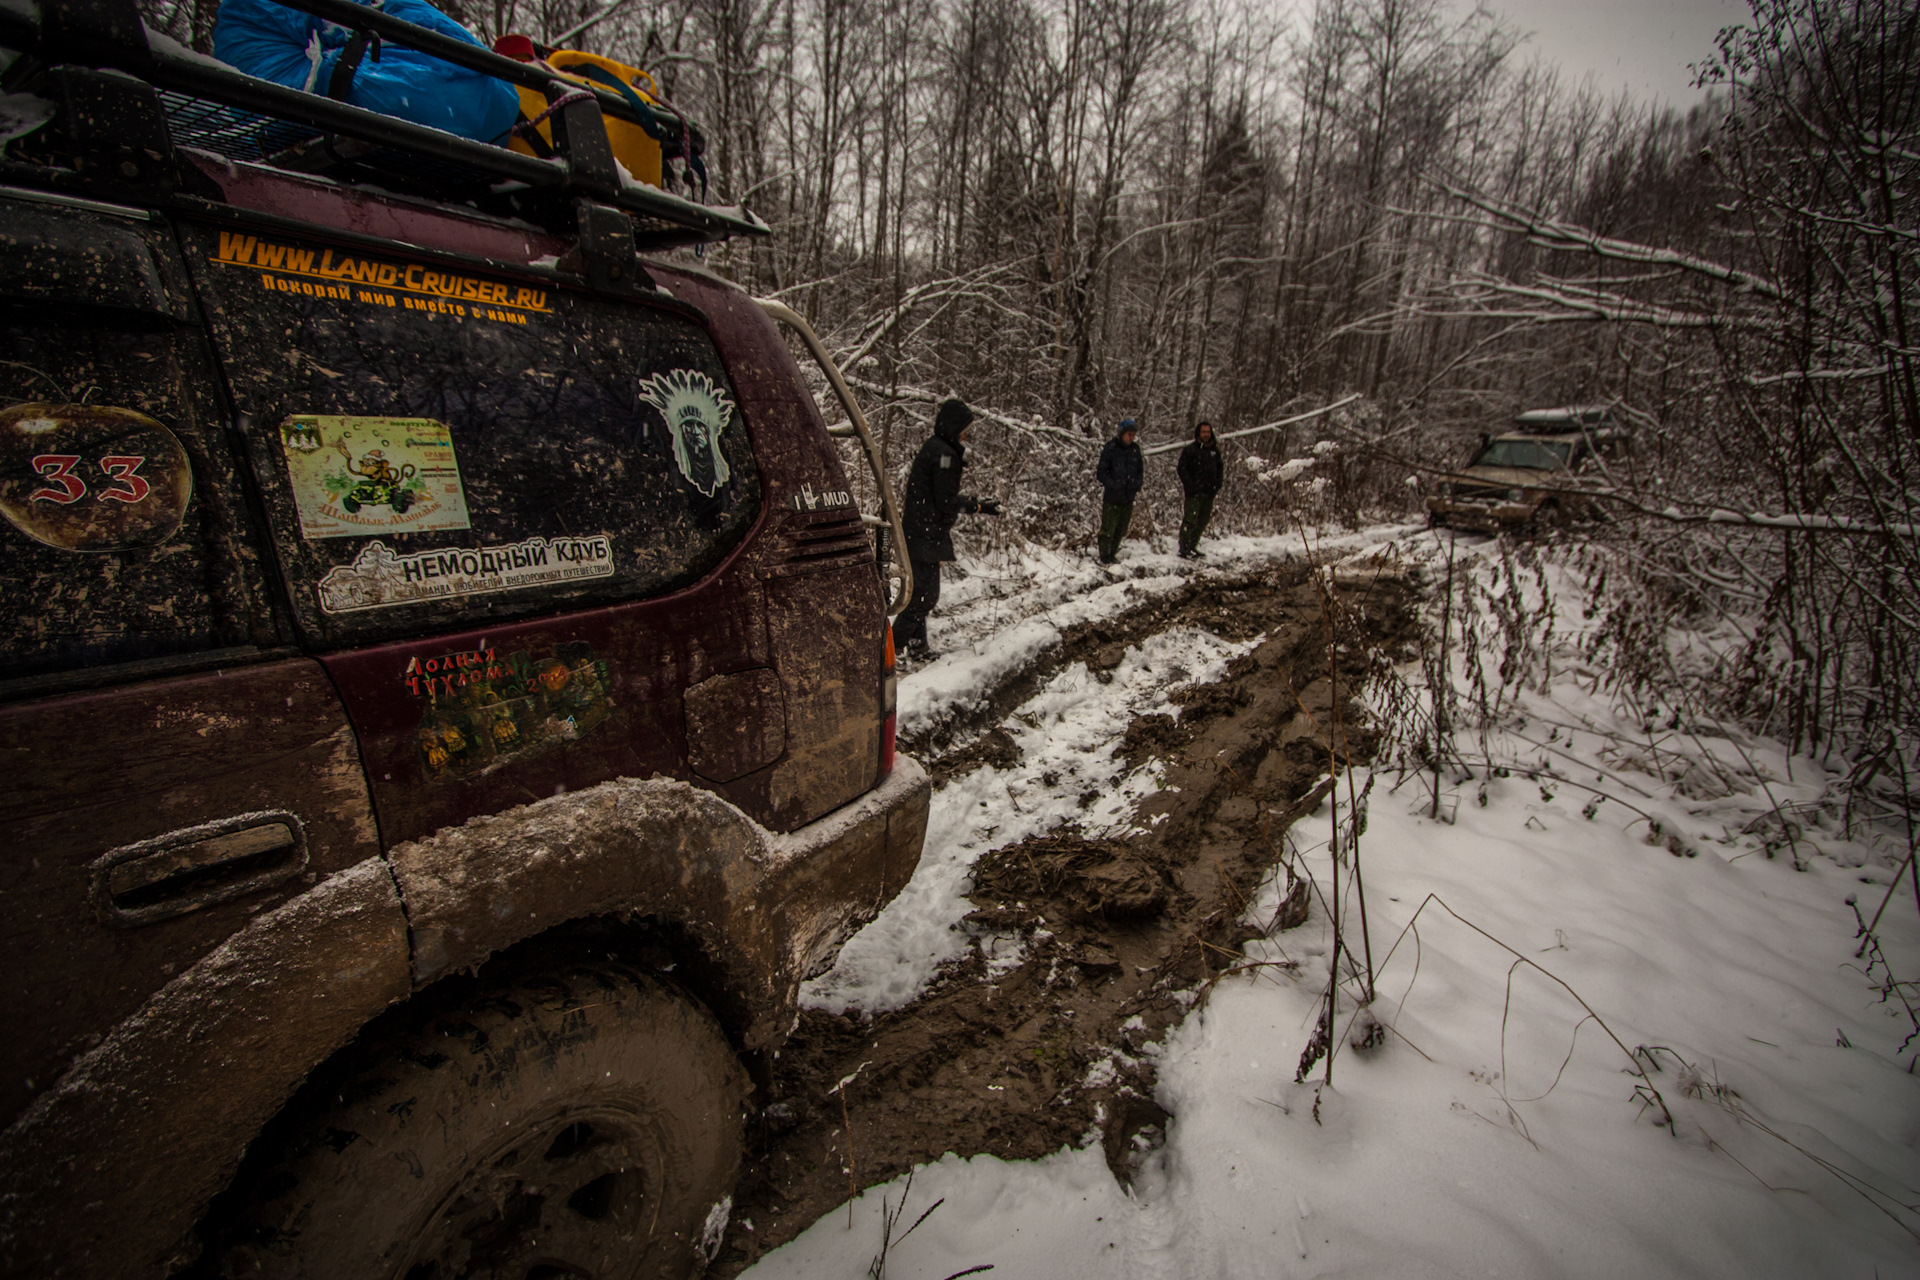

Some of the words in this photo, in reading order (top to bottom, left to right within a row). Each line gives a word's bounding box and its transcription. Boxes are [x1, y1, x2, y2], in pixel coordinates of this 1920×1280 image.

[262, 274, 351, 301] Покоряй
[360, 290, 395, 308] мир
[405, 296, 466, 317] вместе
[472, 306, 481, 319] с
[488, 308, 527, 325] нами
[822, 491, 849, 506] MUD
[403, 543, 548, 582] НЕМОДНЫЙ
[554, 538, 608, 563] КЛУБ
[506, 570, 561, 585] ВНЕДОРОЖНЫХ
[563, 564, 610, 577] ПУТЕШЕСТВИЙ
